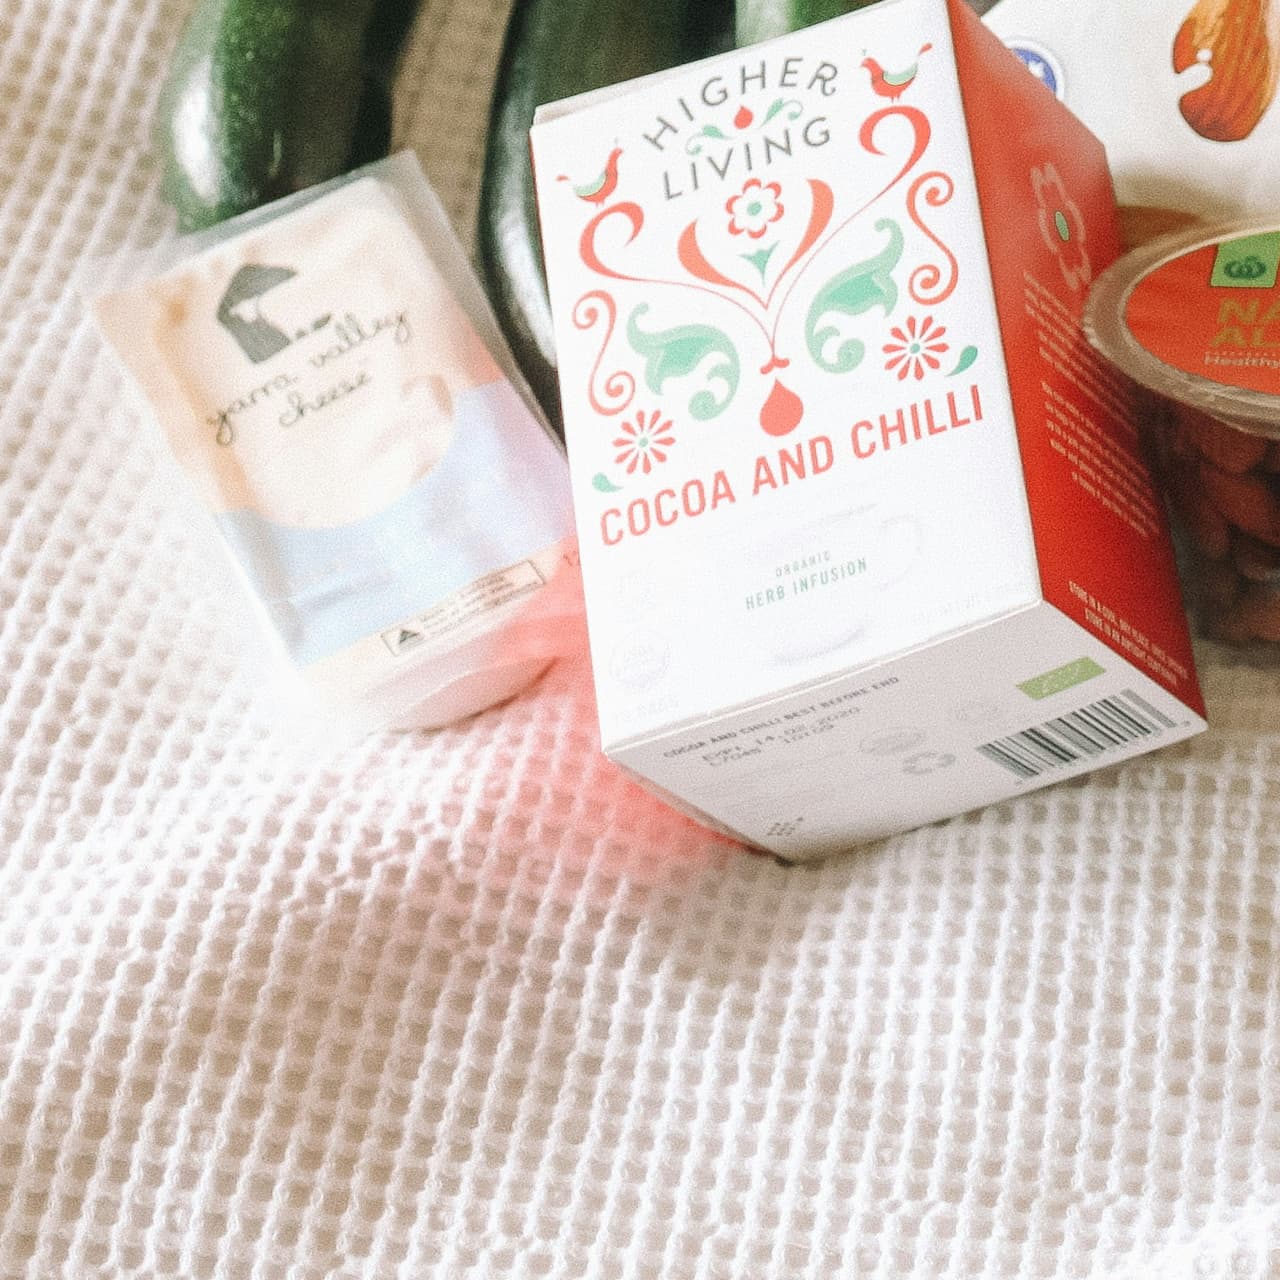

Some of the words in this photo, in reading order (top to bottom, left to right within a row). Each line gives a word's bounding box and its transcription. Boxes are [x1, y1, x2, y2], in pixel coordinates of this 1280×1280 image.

[643, 58, 838, 150] HIGHER
[664, 116, 831, 200] LIVING
[1204, 354, 1280, 370] Healthy
[279, 371, 371, 428] cheese
[600, 469, 736, 547] COCOA
[751, 434, 835, 496] AND
[850, 384, 984, 459] CHILLI
[745, 585, 786, 610] HERB
[793, 557, 868, 596] INFUSION
